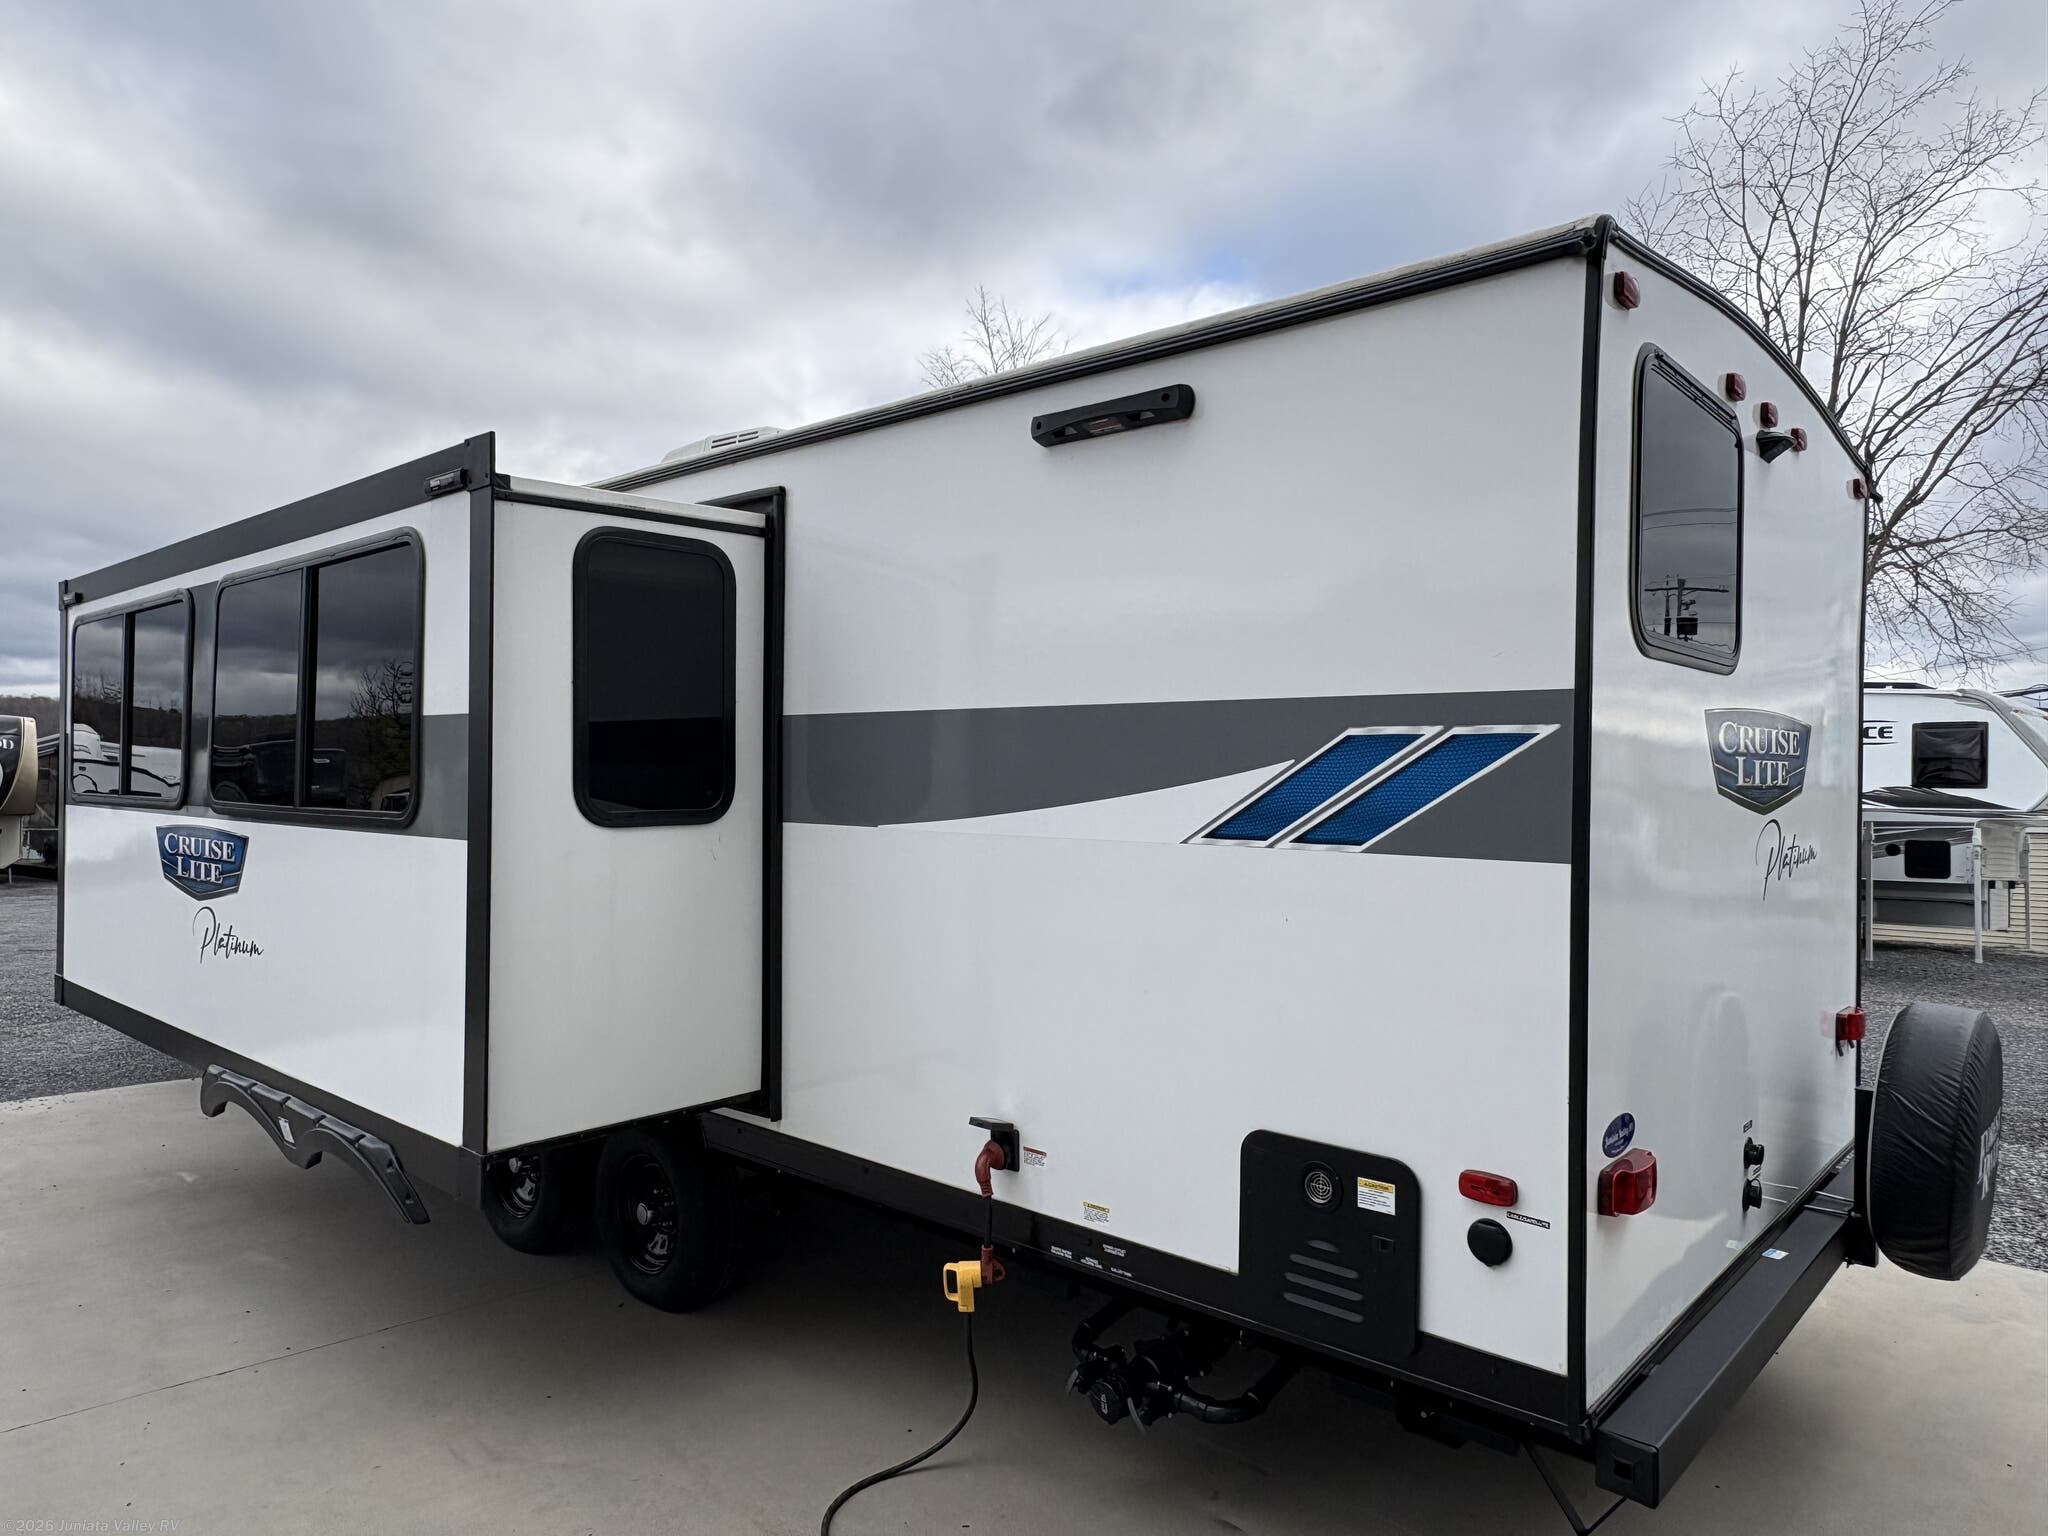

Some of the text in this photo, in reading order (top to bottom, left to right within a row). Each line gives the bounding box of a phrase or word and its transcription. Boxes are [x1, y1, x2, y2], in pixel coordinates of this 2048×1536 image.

[1718, 721, 1801, 757] CRUISE
[1735, 756, 1790, 789] LITE
[164, 832, 236, 862] CRUISE
[1755, 818, 1818, 901] Platinum
[176, 855, 223, 884] LITE
[193, 905, 265, 965] Platinum
